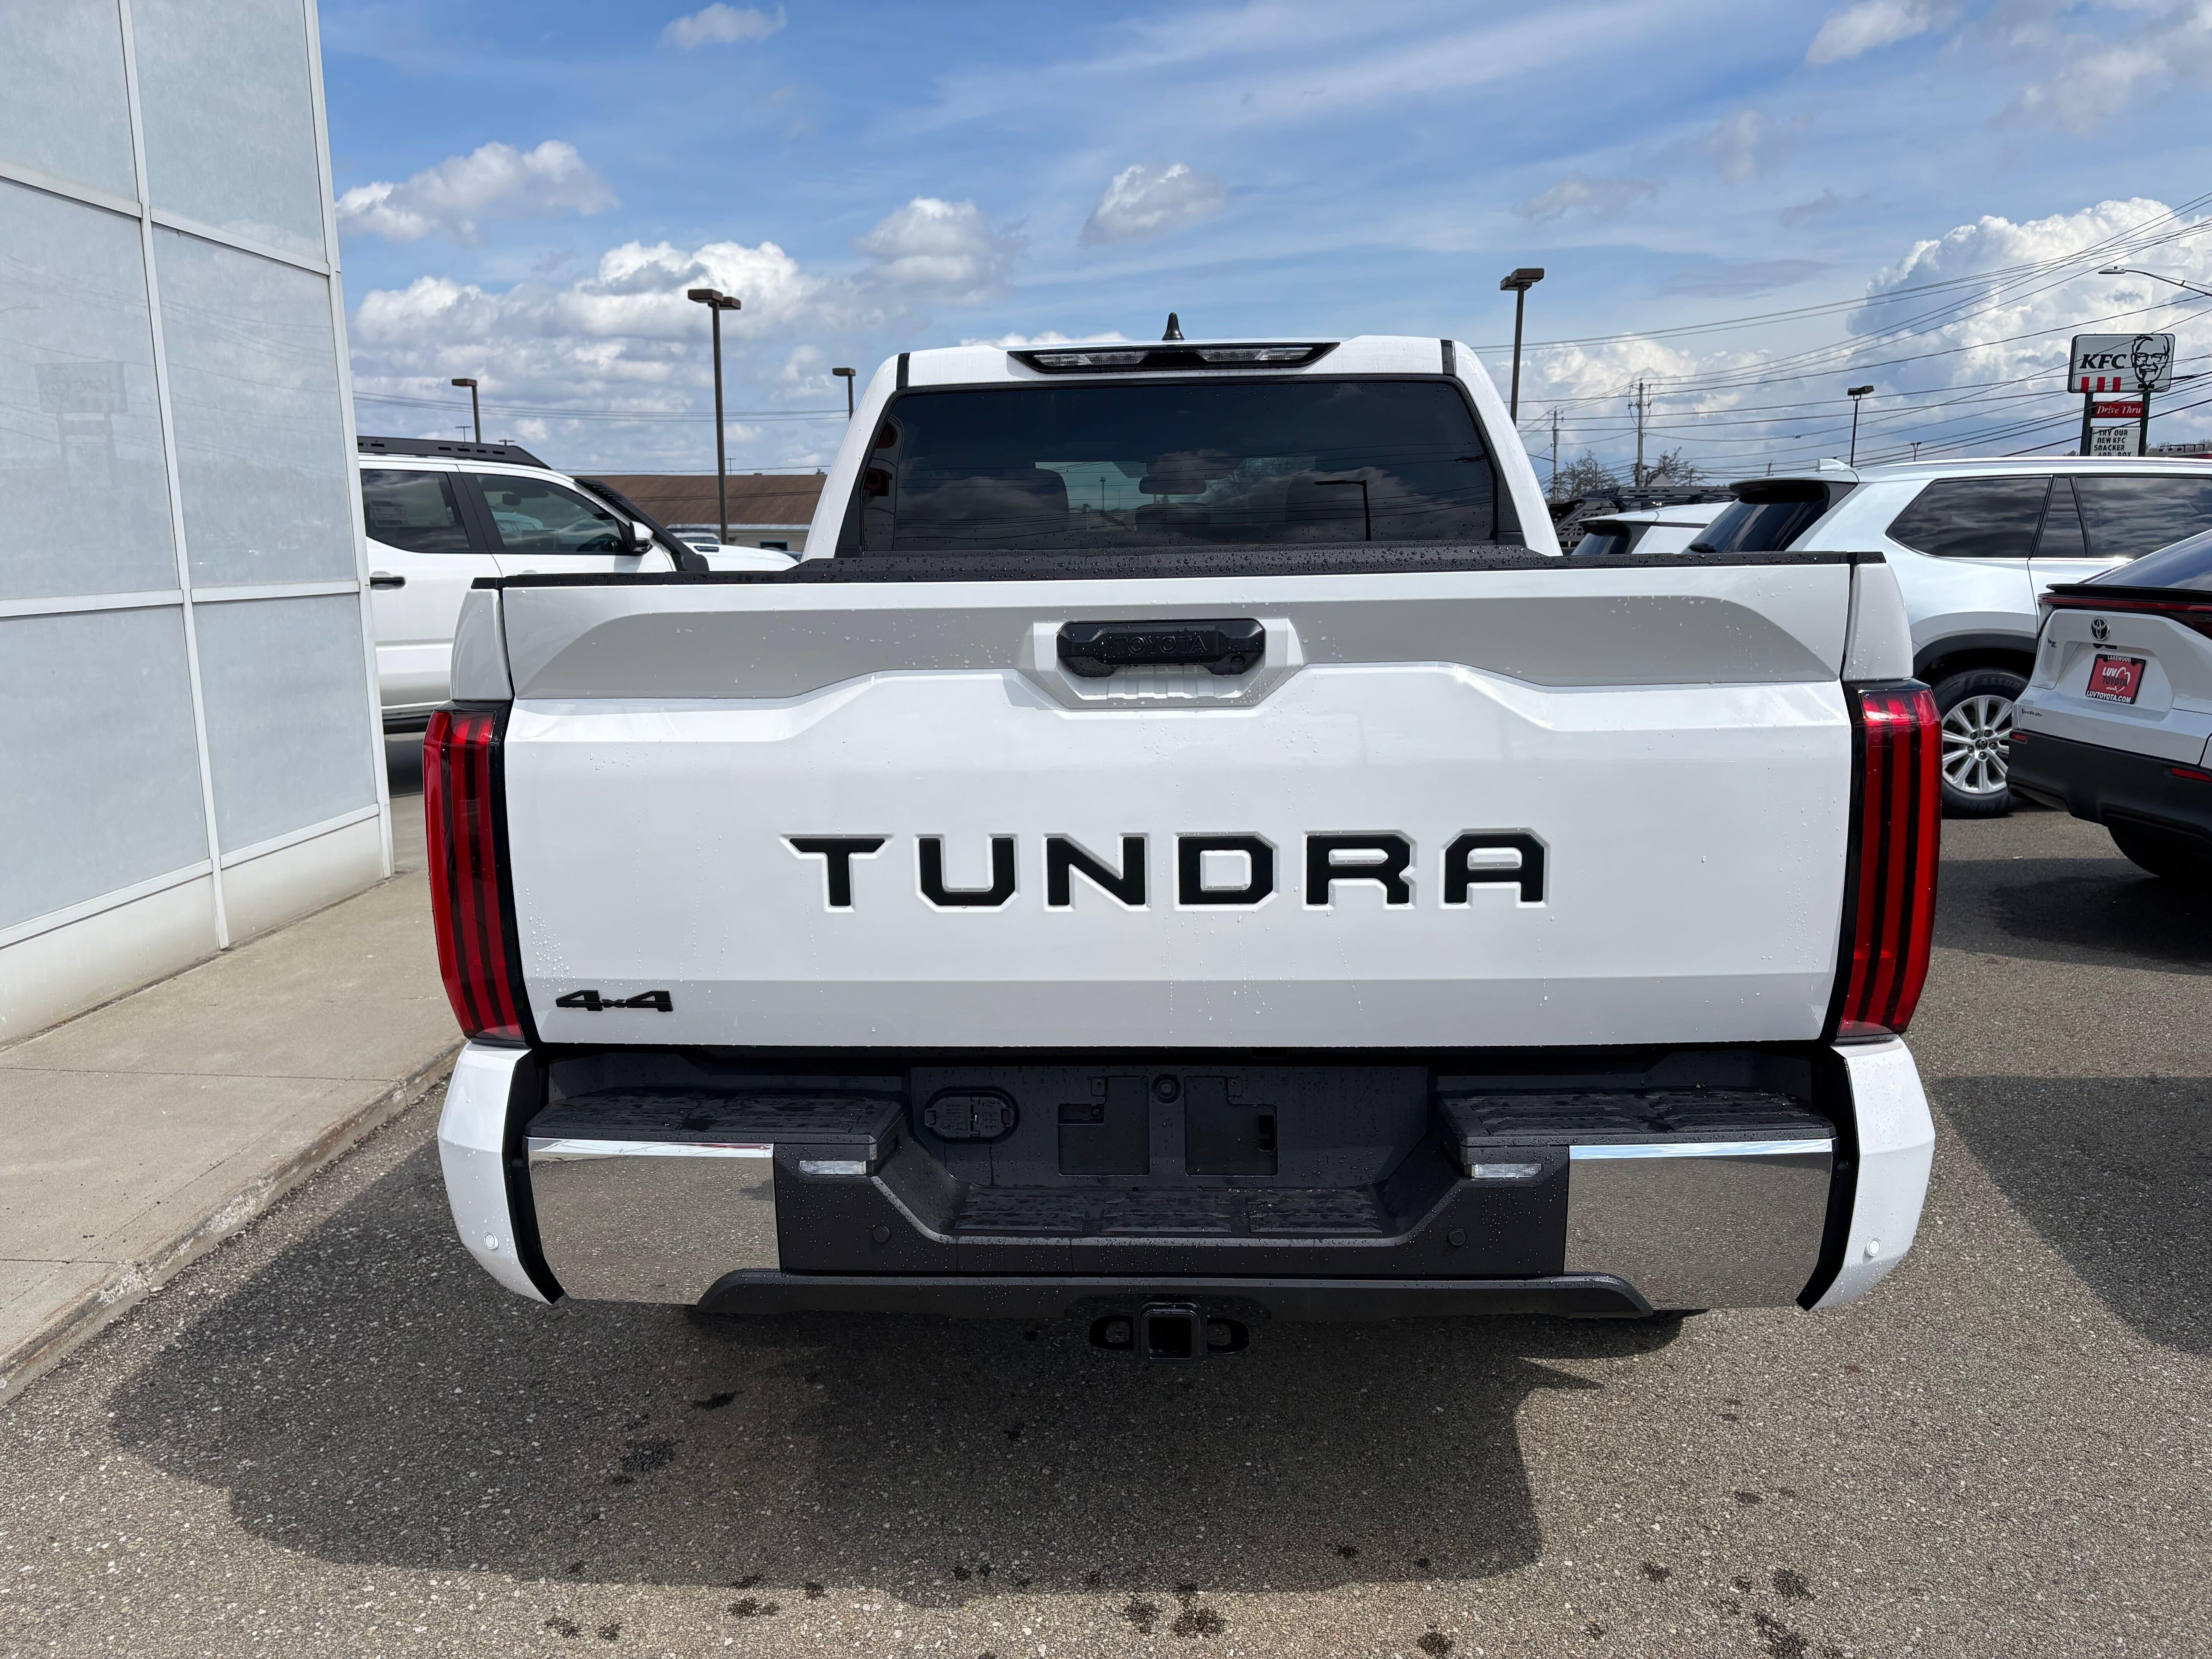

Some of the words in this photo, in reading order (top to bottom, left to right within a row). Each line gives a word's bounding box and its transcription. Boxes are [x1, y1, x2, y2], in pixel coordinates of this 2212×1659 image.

[2079, 354, 2127, 369] KFC
[2097, 405, 2119, 414] Drive
[2122, 405, 2142, 414] Thru
[1113, 635, 1207, 654] TOYOTA
[2102, 667, 2118, 677] LUV
[2102, 676, 2128, 687] TOYOTA
[2086, 690, 2131, 704] LUVTOYOTA.COM
[785, 832, 1546, 908] TUNDRA
